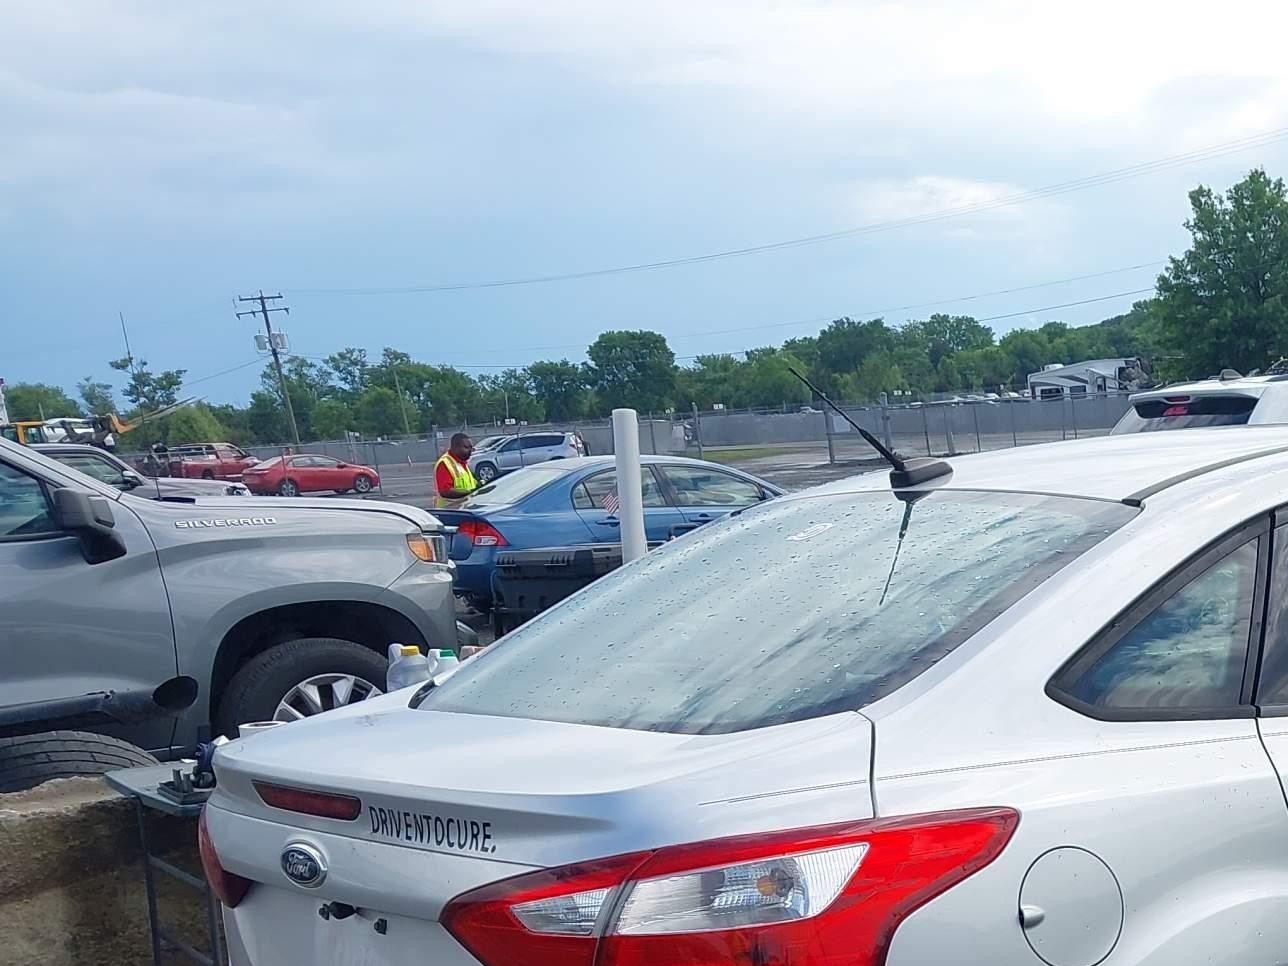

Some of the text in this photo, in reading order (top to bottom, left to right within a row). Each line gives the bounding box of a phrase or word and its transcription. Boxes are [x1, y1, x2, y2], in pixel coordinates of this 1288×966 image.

[175, 516, 278, 529] SILVERADO
[368, 805, 497, 854] DRIVENTOCURE.
[286, 852, 312, 877] Ford
